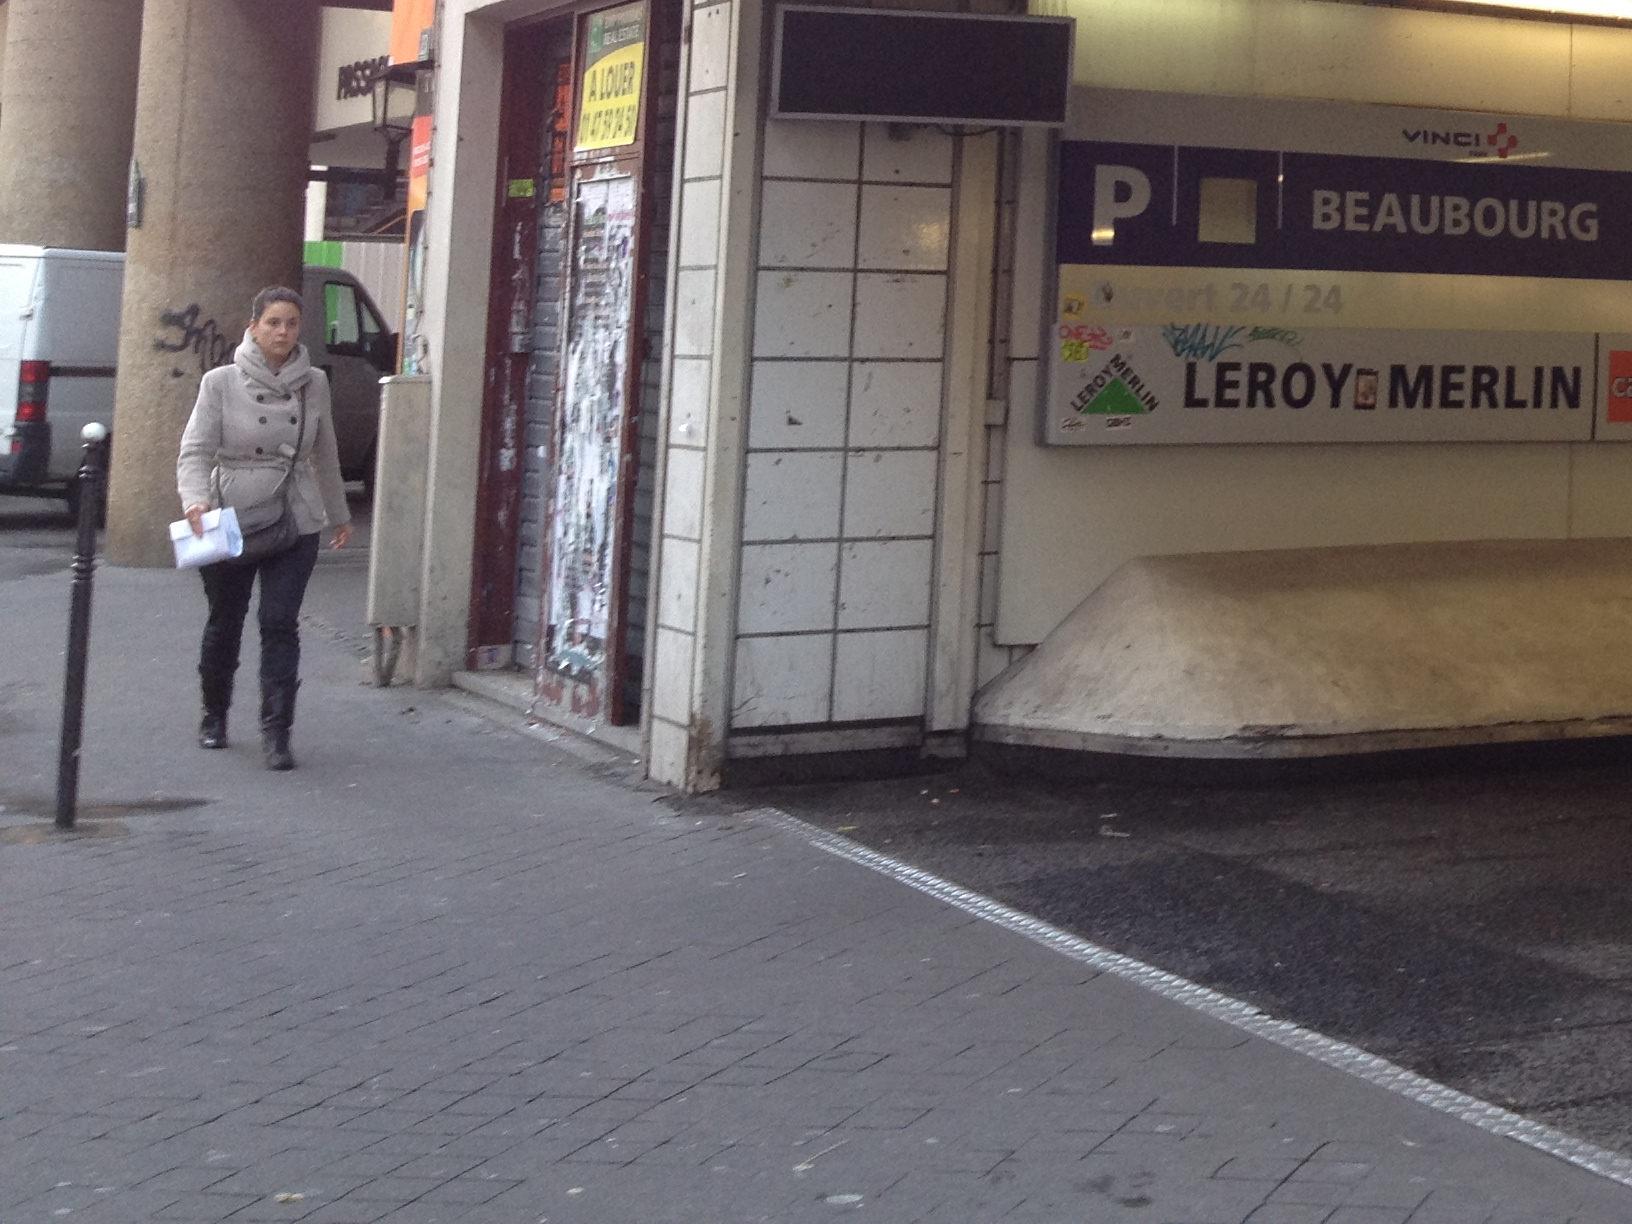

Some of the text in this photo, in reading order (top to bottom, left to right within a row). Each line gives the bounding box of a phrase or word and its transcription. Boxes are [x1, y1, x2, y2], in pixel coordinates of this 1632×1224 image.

[600, 61, 636, 101] LOUER
[1402, 128, 1480, 147] VINCI
[1091, 163, 1151, 247] P
[1312, 189, 1599, 243] BEAUBOURG
[1228, 282, 1274, 314] 24
[1302, 284, 1342, 314] 24
[1069, 353, 1160, 413] LEROY MERLIN
[1182, 360, 1582, 410] LEROY MERLIN
